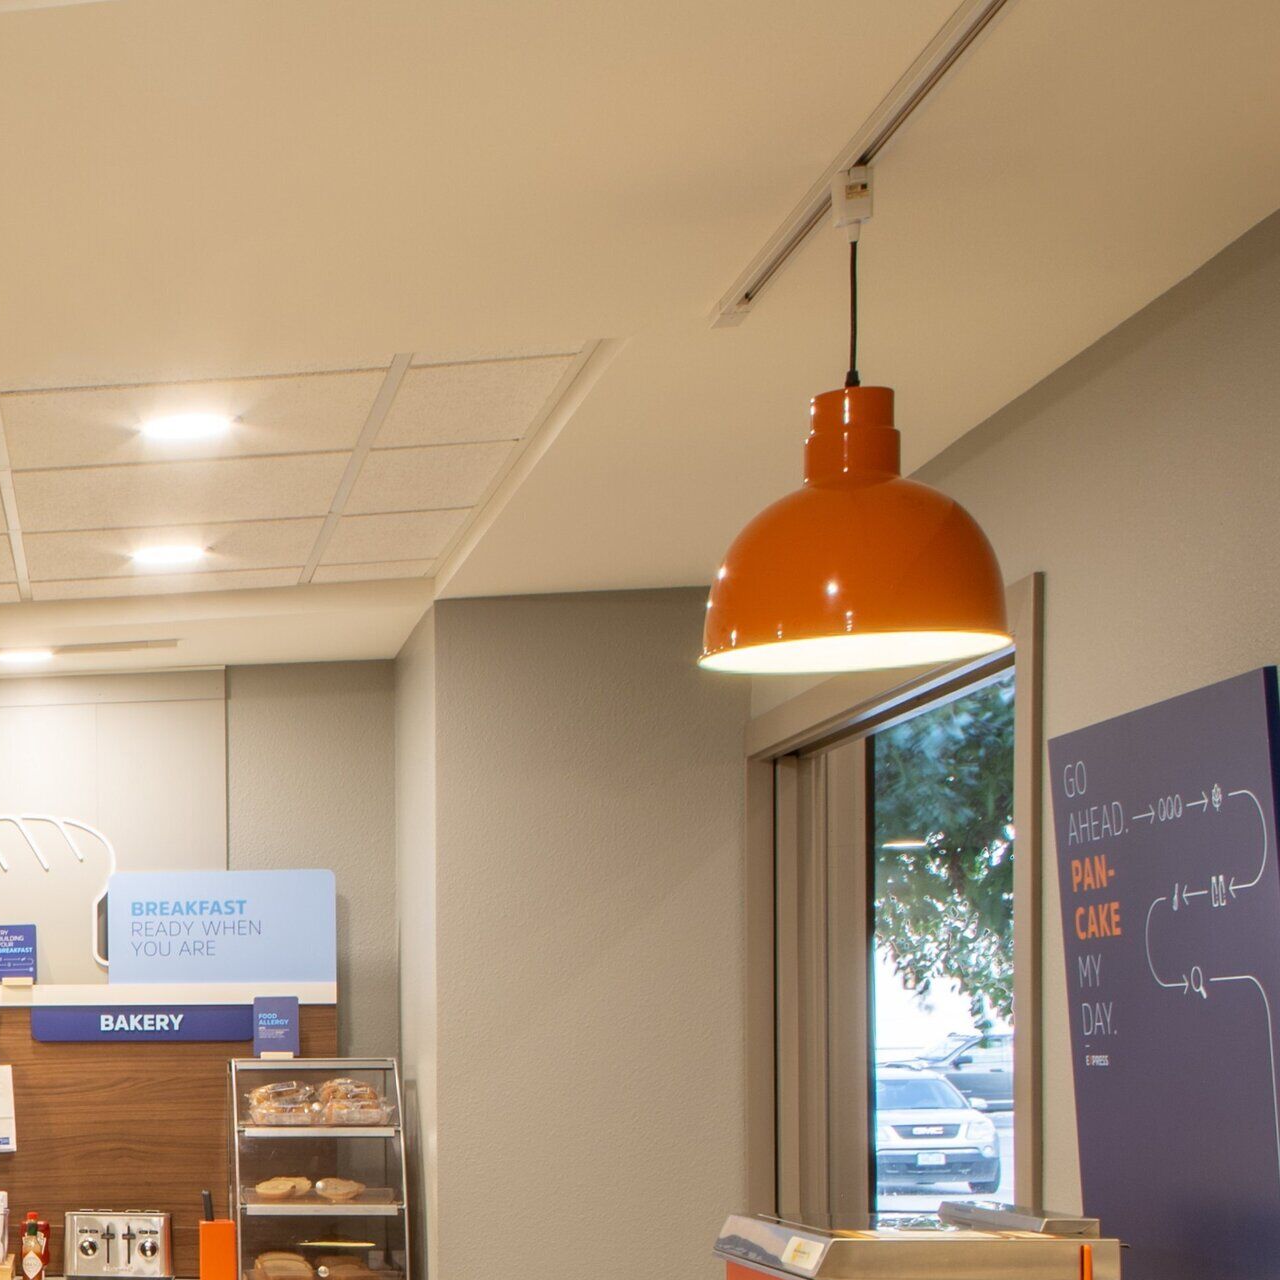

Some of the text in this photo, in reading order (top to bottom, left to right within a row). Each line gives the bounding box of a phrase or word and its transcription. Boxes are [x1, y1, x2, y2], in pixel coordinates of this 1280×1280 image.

[1063, 760, 1088, 799] GO
[1068, 800, 1130, 847] AHEAD.
[1071, 854, 1116, 894] PAN-
[131, 899, 248, 917] BREAKFAST
[1075, 901, 1122, 942] CAKE
[131, 919, 263, 938] READY WHEN
[131, 939, 217, 958] YOU ARE
[1078, 952, 1102, 989] MY
[99, 1013, 185, 1032] BAKERY
[1081, 1001, 1118, 1036] DAY.
[912, 1125, 945, 1136] GMC
